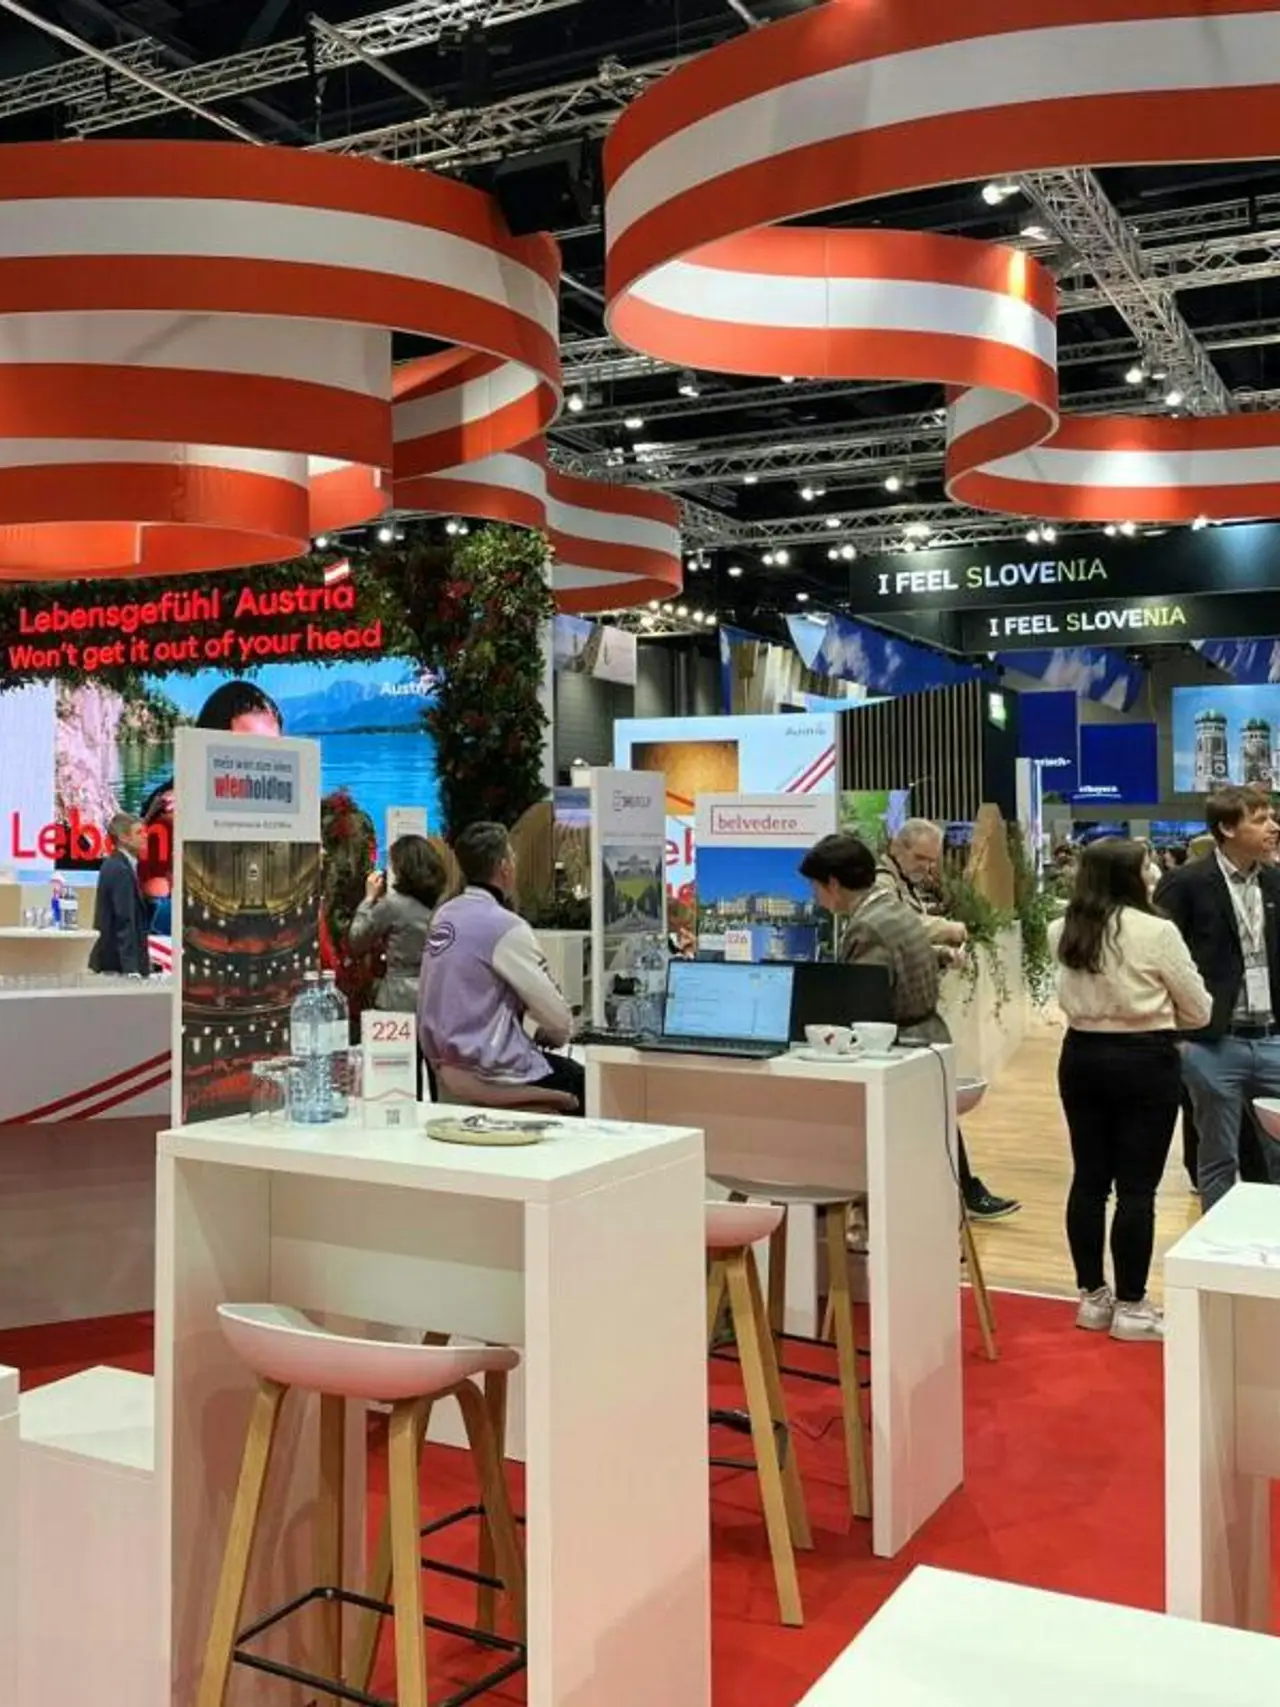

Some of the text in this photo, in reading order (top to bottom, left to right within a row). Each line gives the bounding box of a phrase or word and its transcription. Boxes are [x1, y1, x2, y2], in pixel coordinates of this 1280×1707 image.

[878, 557, 1108, 595] I FEEL SLOVENIA
[19, 583, 356, 633] Lebensgefühl Austria
[989, 605, 1187, 637] I FEEL SLOVENIA
[8, 620, 382, 671] Won't get it out of your head
[718, 813, 798, 831] belvedere
[372, 1020, 411, 1041] 224
